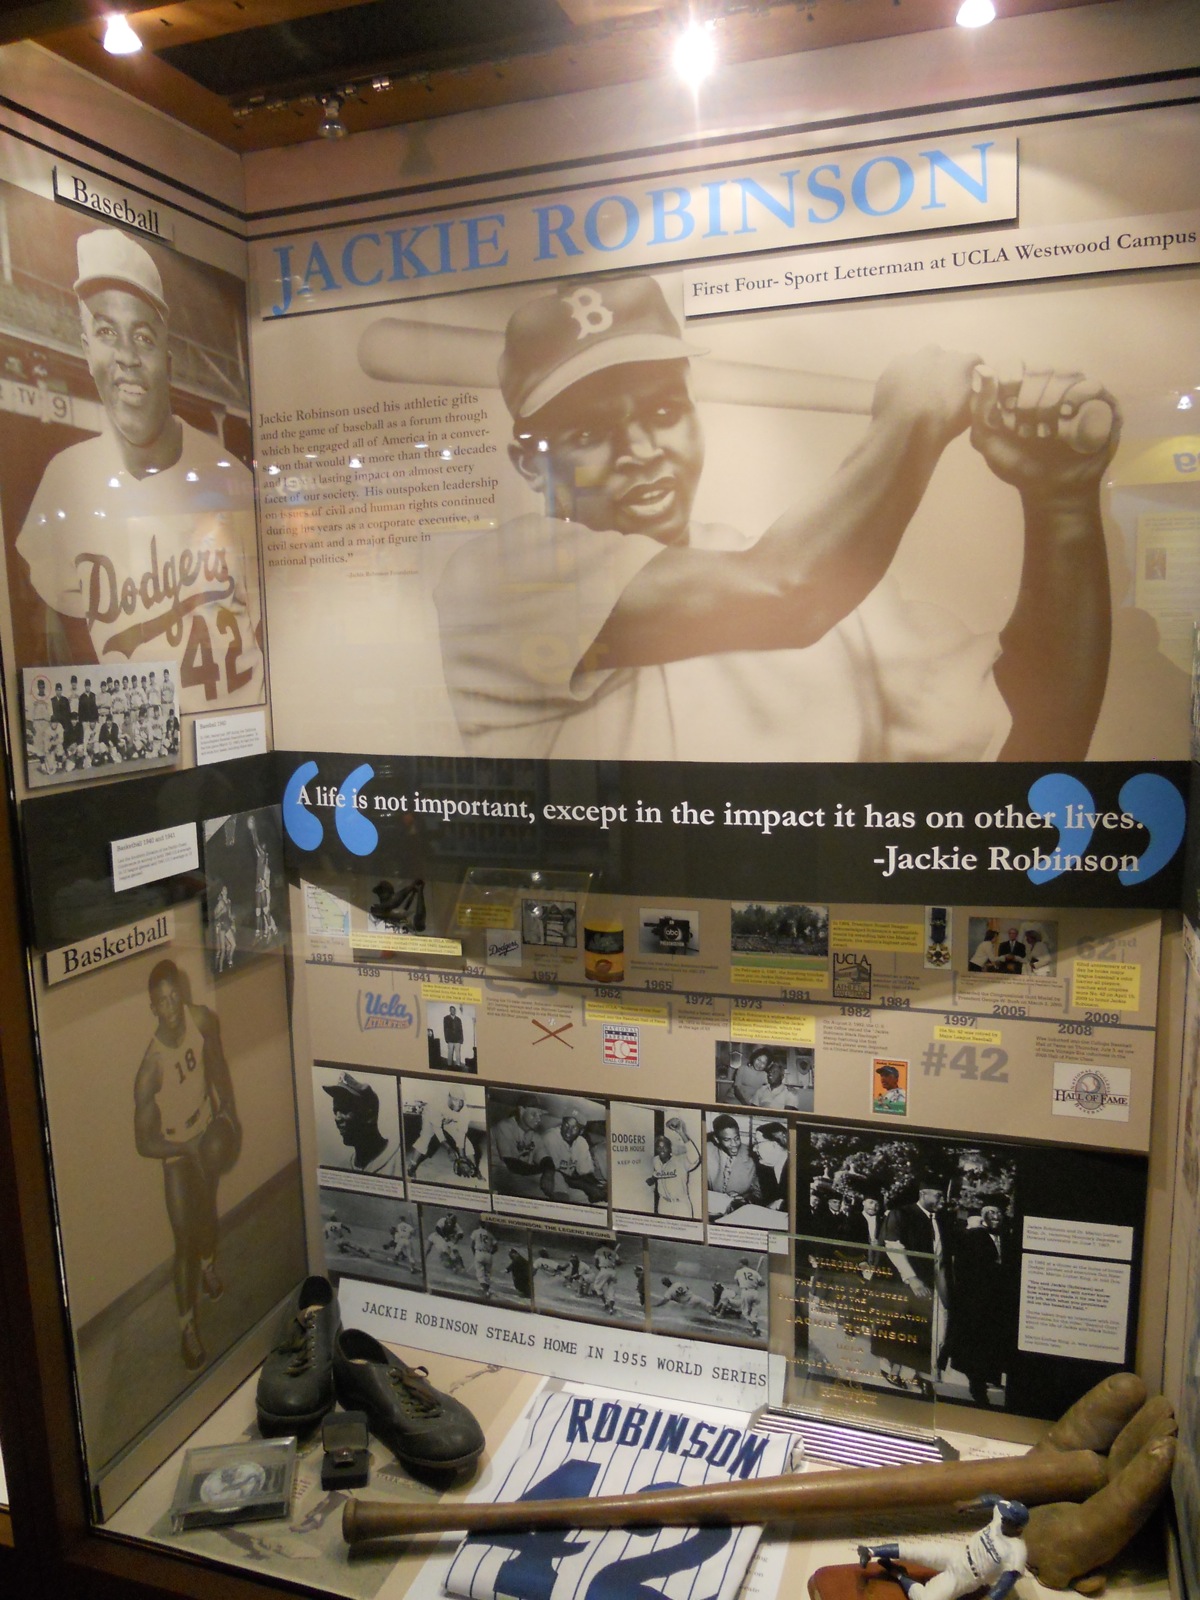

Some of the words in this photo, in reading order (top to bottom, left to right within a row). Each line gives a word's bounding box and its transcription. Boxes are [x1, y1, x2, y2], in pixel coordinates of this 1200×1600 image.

[71, 176, 159, 235] Baseball
[272, 214, 509, 316] JACKIE
[532, 141, 995, 262] ROBINSON
[692, 281, 730, 297] First
[735, 276, 779, 292] Four-
[784, 271, 828, 289] Sport
[834, 260, 924, 280] Letterman
[930, 256, 946, 270] at
[952, 247, 1010, 267] UCLA
[1015, 236, 1110, 260] Westwood
[1117, 231, 1197, 251] Campus
[561, 287, 613, 339] B
[259, 412, 292, 428] Jackie
[296, 408, 349, 422] Robinson
[353, 403, 379, 415] used
[383, 399, 400, 412] his
[404, 397, 448, 410] athletic
[452, 393, 479, 408] gifts
[261, 430, 278, 440] and
[281, 428, 297, 438] the
[299, 428, 325, 440] game
[328, 424, 339, 434] of
[343, 420, 384, 432] baseball
[387, 419, 397, 428] as
[410, 415, 441, 426] forum
[445, 410, 488, 426] through
[262, 444, 290, 456] which
[293, 443, 304, 454] he
[307, 438, 349, 454] engaged
[352, 436, 364, 448] all
[367, 436, 378, 447] of
[382, 433, 425, 445] America
[428, 431, 438, 441] in
[441, 432, 447, 440] a
[451, 429, 490, 440] conver-
[294, 458, 313, 469] that
[316, 456, 345, 468] would
[369, 454, 394, 464] more
[398, 450, 421, 461] than
[454, 443, 497, 456] decades
[318, 471, 351, 486] lasting
[355, 471, 389, 483] impact
[393, 470, 405, 478] on
[408, 466, 443, 478] almost
[446, 464, 474, 475] every
[265, 493, 287, 504] facet
[290, 491, 300, 503] of
[304, 491, 320, 501] our
[323, 488, 358, 502] society.
[365, 486, 383, 497] His
[386, 482, 439, 497] outspoken
[443, 477, 498, 493] leadership
[265, 511, 277, 520] on
[312, 506, 322, 517] of
[326, 505, 346, 516] civil
[348, 504, 367, 514] and
[370, 501, 405, 512] human
[408, 498, 439, 512] rights
[442, 494, 495, 508] continued
[266, 523, 297, 537] during
[317, 523, 343, 536] years
[345, 523, 356, 532] as
[368, 519, 415, 532] corporate
[419, 514, 471, 527] executive,
[267, 540, 287, 552] civil
[289, 540, 324, 550] servant
[327, 537, 345, 548] and
[348, 539, 353, 547] a
[356, 536, 385, 549] major
[388, 533, 418, 545] figure
[421, 533, 431, 543] in
[268, 556, 306, 568] national
[74, 535, 229, 647] Dodgers
[180, 609, 253, 701] 42
[297, 785, 312, 805] A
[315, 787, 346, 808] life
[352, 788, 368, 810] is
[374, 792, 408, 812] not
[413, 791, 536, 825] important,
[543, 803, 628, 830] except
[635, 801, 662, 825] in
[671, 801, 715, 826] the
[723, 802, 825, 834] impact
[834, 803, 855, 828] it
[865, 804, 915, 829] has
[926, 810, 964, 829] on
[975, 805, 1056, 830] other
[1064, 804, 1144, 831] lives.
[873, 845, 978, 877] -Jackie
[988, 846, 1140, 873] Robinson
[63, 916, 169, 974] Basketball
[488, 940, 519, 957] Dodgers
[311, 953, 334, 963] 1919
[836, 953, 869, 965] UCLA
[357, 968, 380, 978] 1939
[408, 972, 431, 982] 1941
[438, 974, 463, 985] 1944
[594, 988, 621, 999] 1962
[644, 980, 672, 990] 1965
[782, 989, 810, 1000] 1981
[684, 994, 713, 1006] 1972
[734, 999, 762, 1010] 1973
[880, 996, 910, 1008] 1984
[992, 1004, 1026, 1017] 2005
[840, 1006, 870, 1018] 1982
[944, 1015, 976, 1027] 1997
[1084, 1011, 1119, 1024] 2009
[1057, 1023, 1092, 1036] 2008
[175, 1047, 197, 1084] 18
[920, 1042, 1009, 1083] #42
[1056, 1090, 1084, 1101] HALL
[1101, 1094, 1128, 1106] FAME
[612, 1133, 646, 1144] DODGERS
[743, 1272, 753, 1281] 12
[362, 1301, 408, 1321] JACKIE
[415, 1311, 479, 1336] ROBINSON
[486, 1327, 536, 1347] STEALS
[543, 1337, 578, 1356] HOME
[588, 1344, 604, 1360] IN
[613, 1349, 648, 1368] 1955
[657, 1357, 703, 1377] WORLD
[711, 1366, 767, 1387] SERIES
[843, 1323, 918, 1344] ROBINSON
[567, 1398, 770, 1480] ROBINSON
